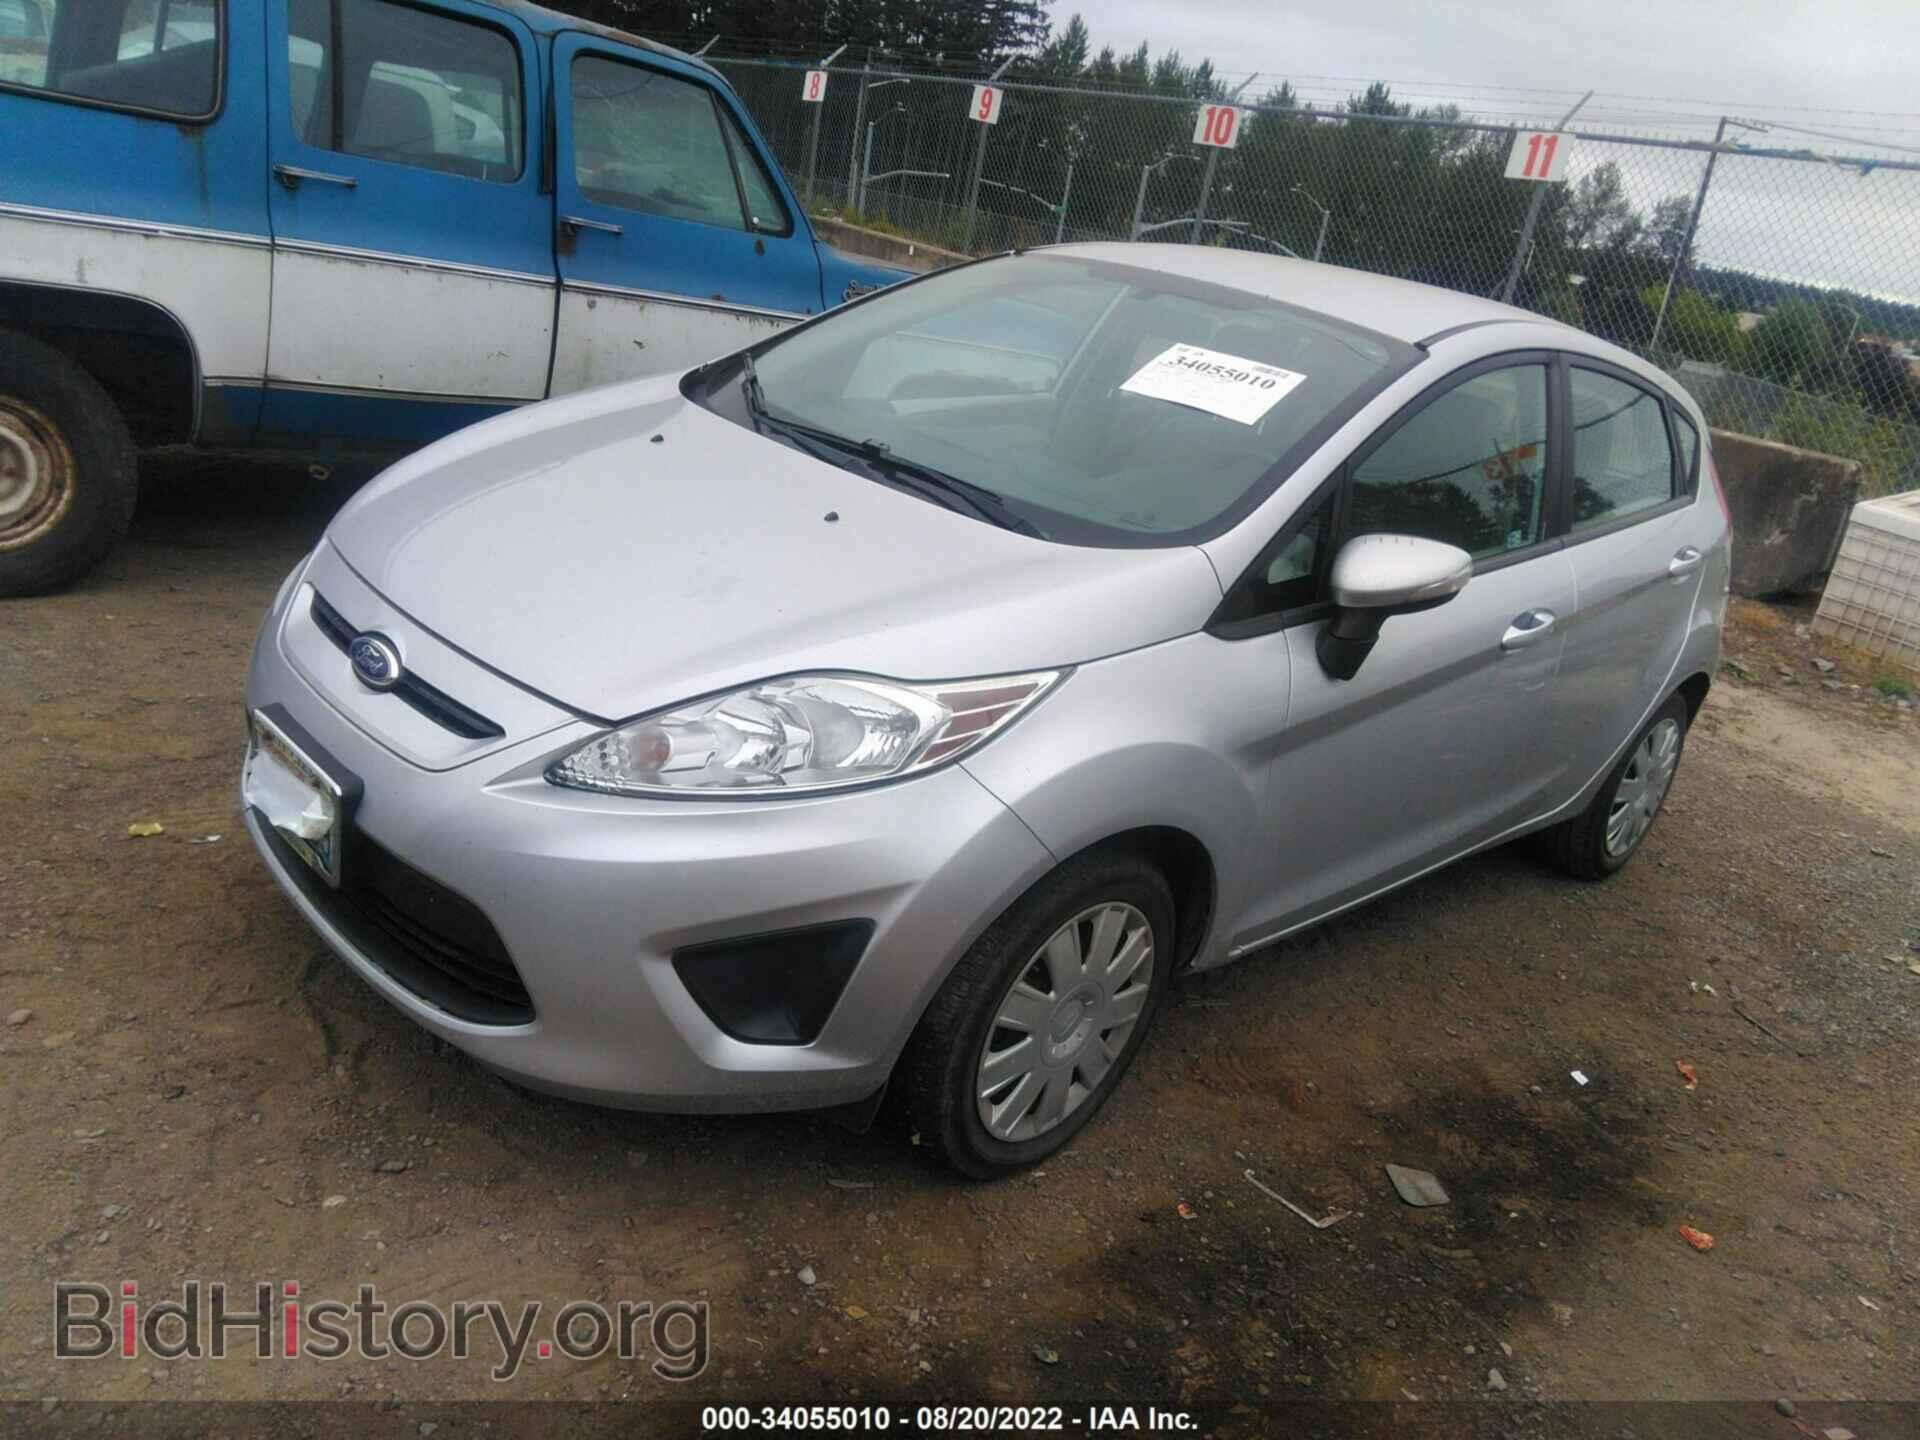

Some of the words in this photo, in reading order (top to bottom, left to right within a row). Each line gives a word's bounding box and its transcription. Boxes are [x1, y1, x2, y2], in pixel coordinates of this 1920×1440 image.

[810, 72, 820, 99] 8
[979, 88, 993, 120] 9
[1203, 106, 1234, 145] 10
[1522, 133, 1558, 177] 11
[1168, 355, 1277, 390] 34055010
